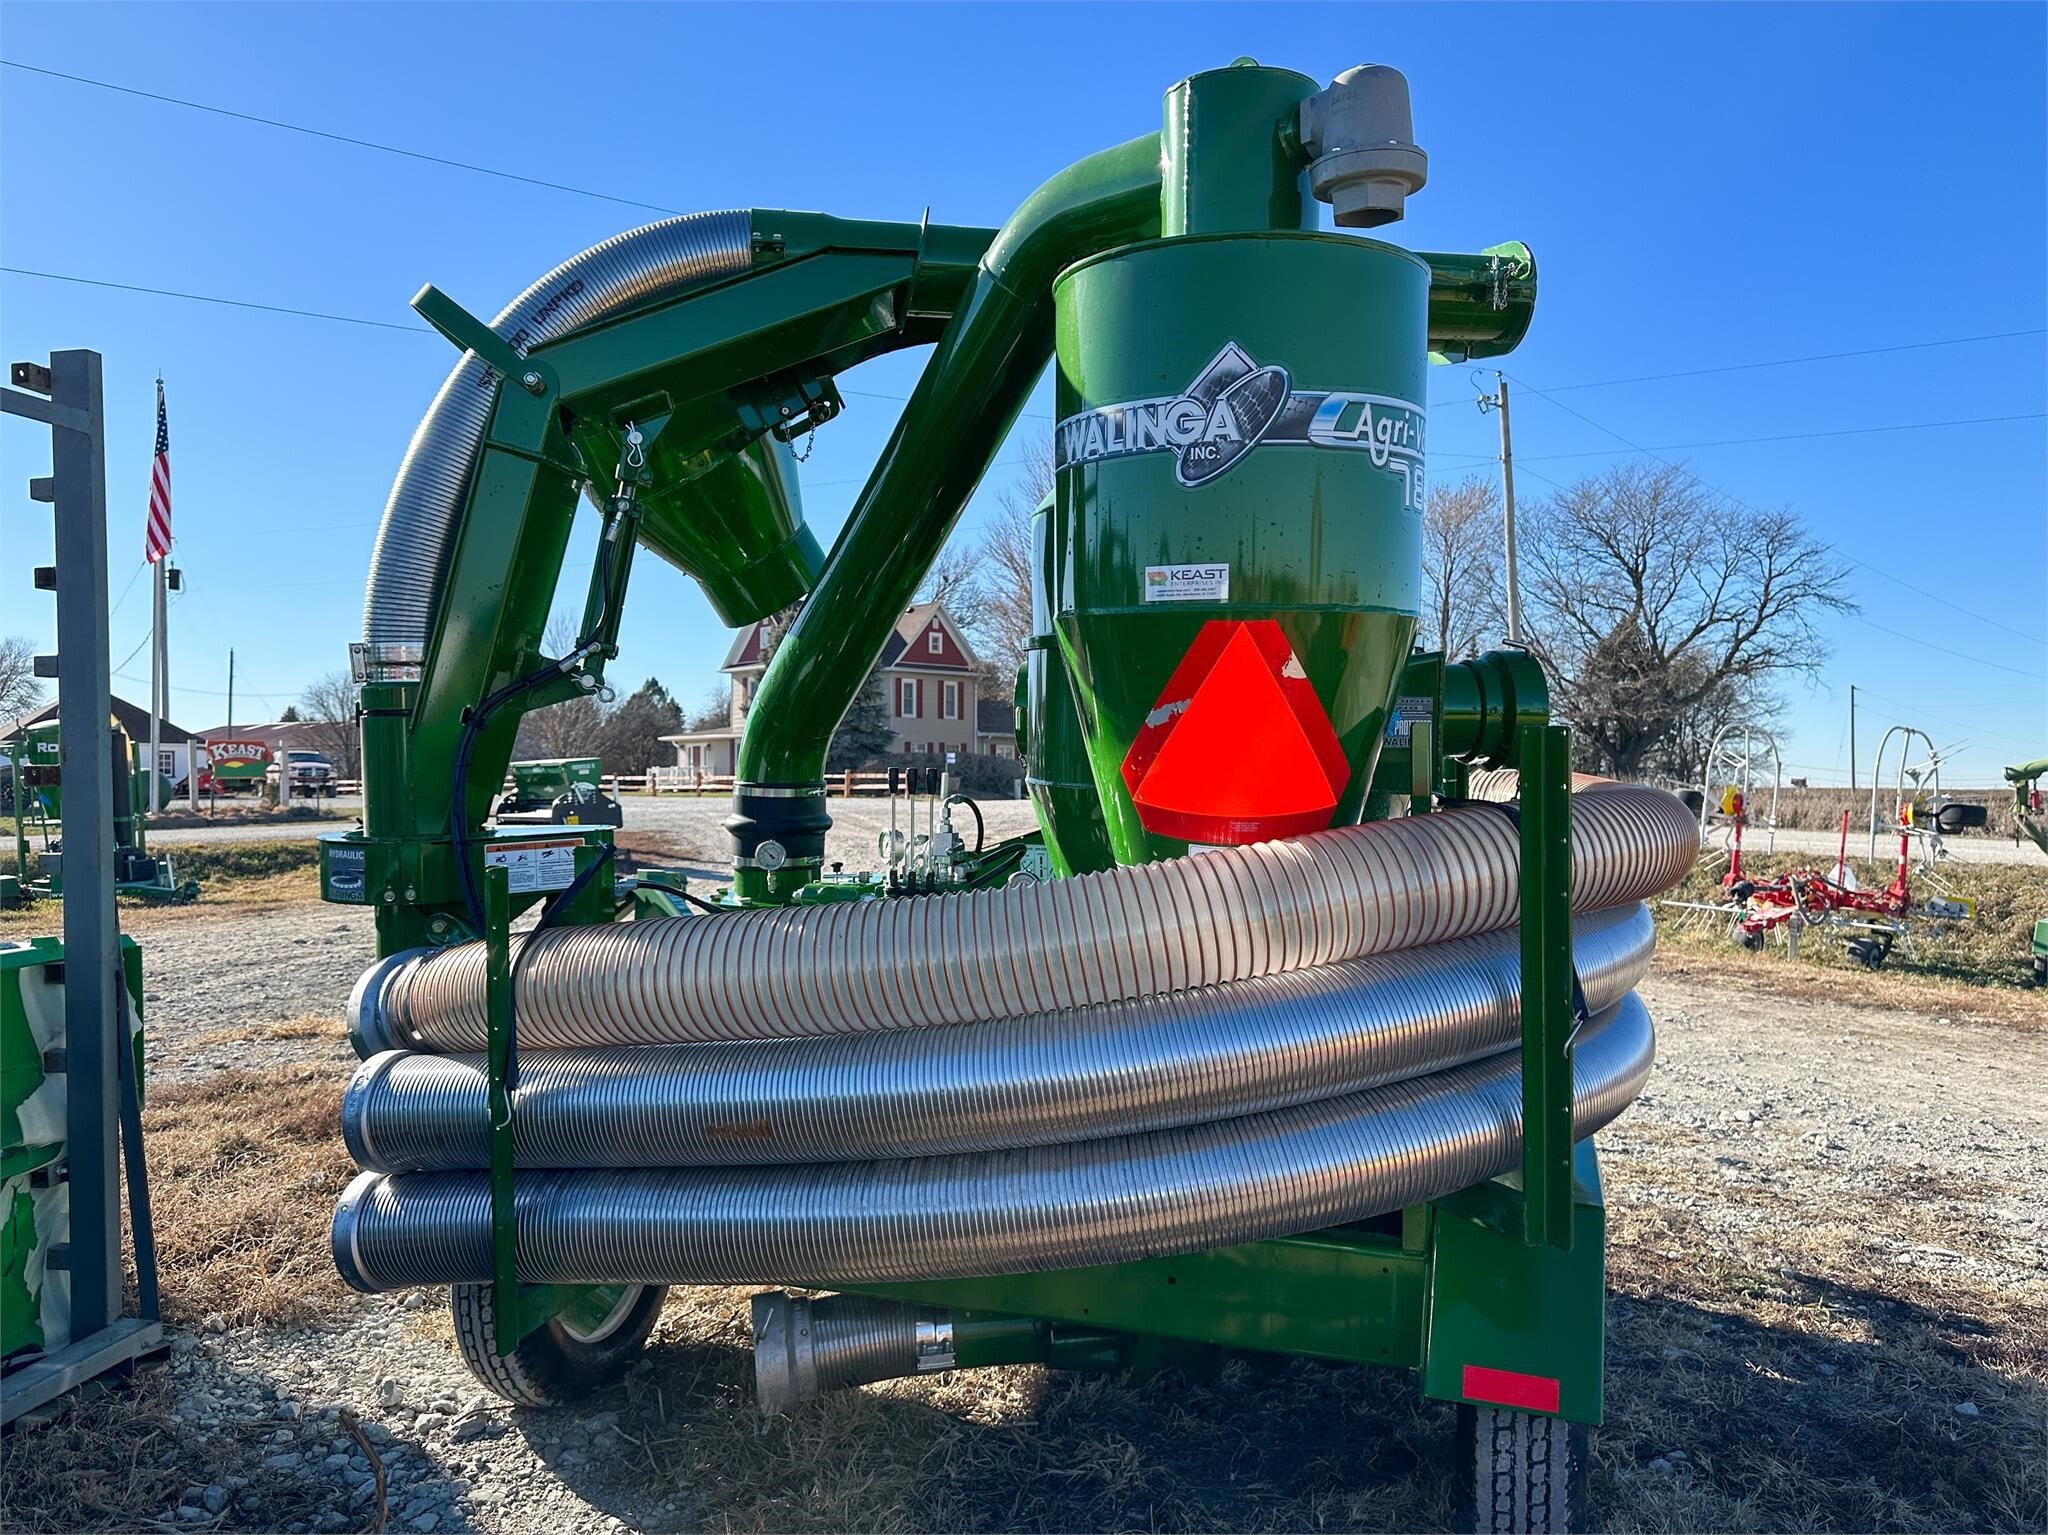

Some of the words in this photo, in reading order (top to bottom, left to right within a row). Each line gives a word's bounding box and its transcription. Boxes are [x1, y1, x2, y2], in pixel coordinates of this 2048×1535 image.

[1064, 398, 1242, 463] WALINGA
[1190, 446, 1221, 460] INC.
[1170, 568, 1227, 581] KEAST
[209, 743, 266, 760] KEAST
[328, 849, 364, 860] HYDRAULIC
